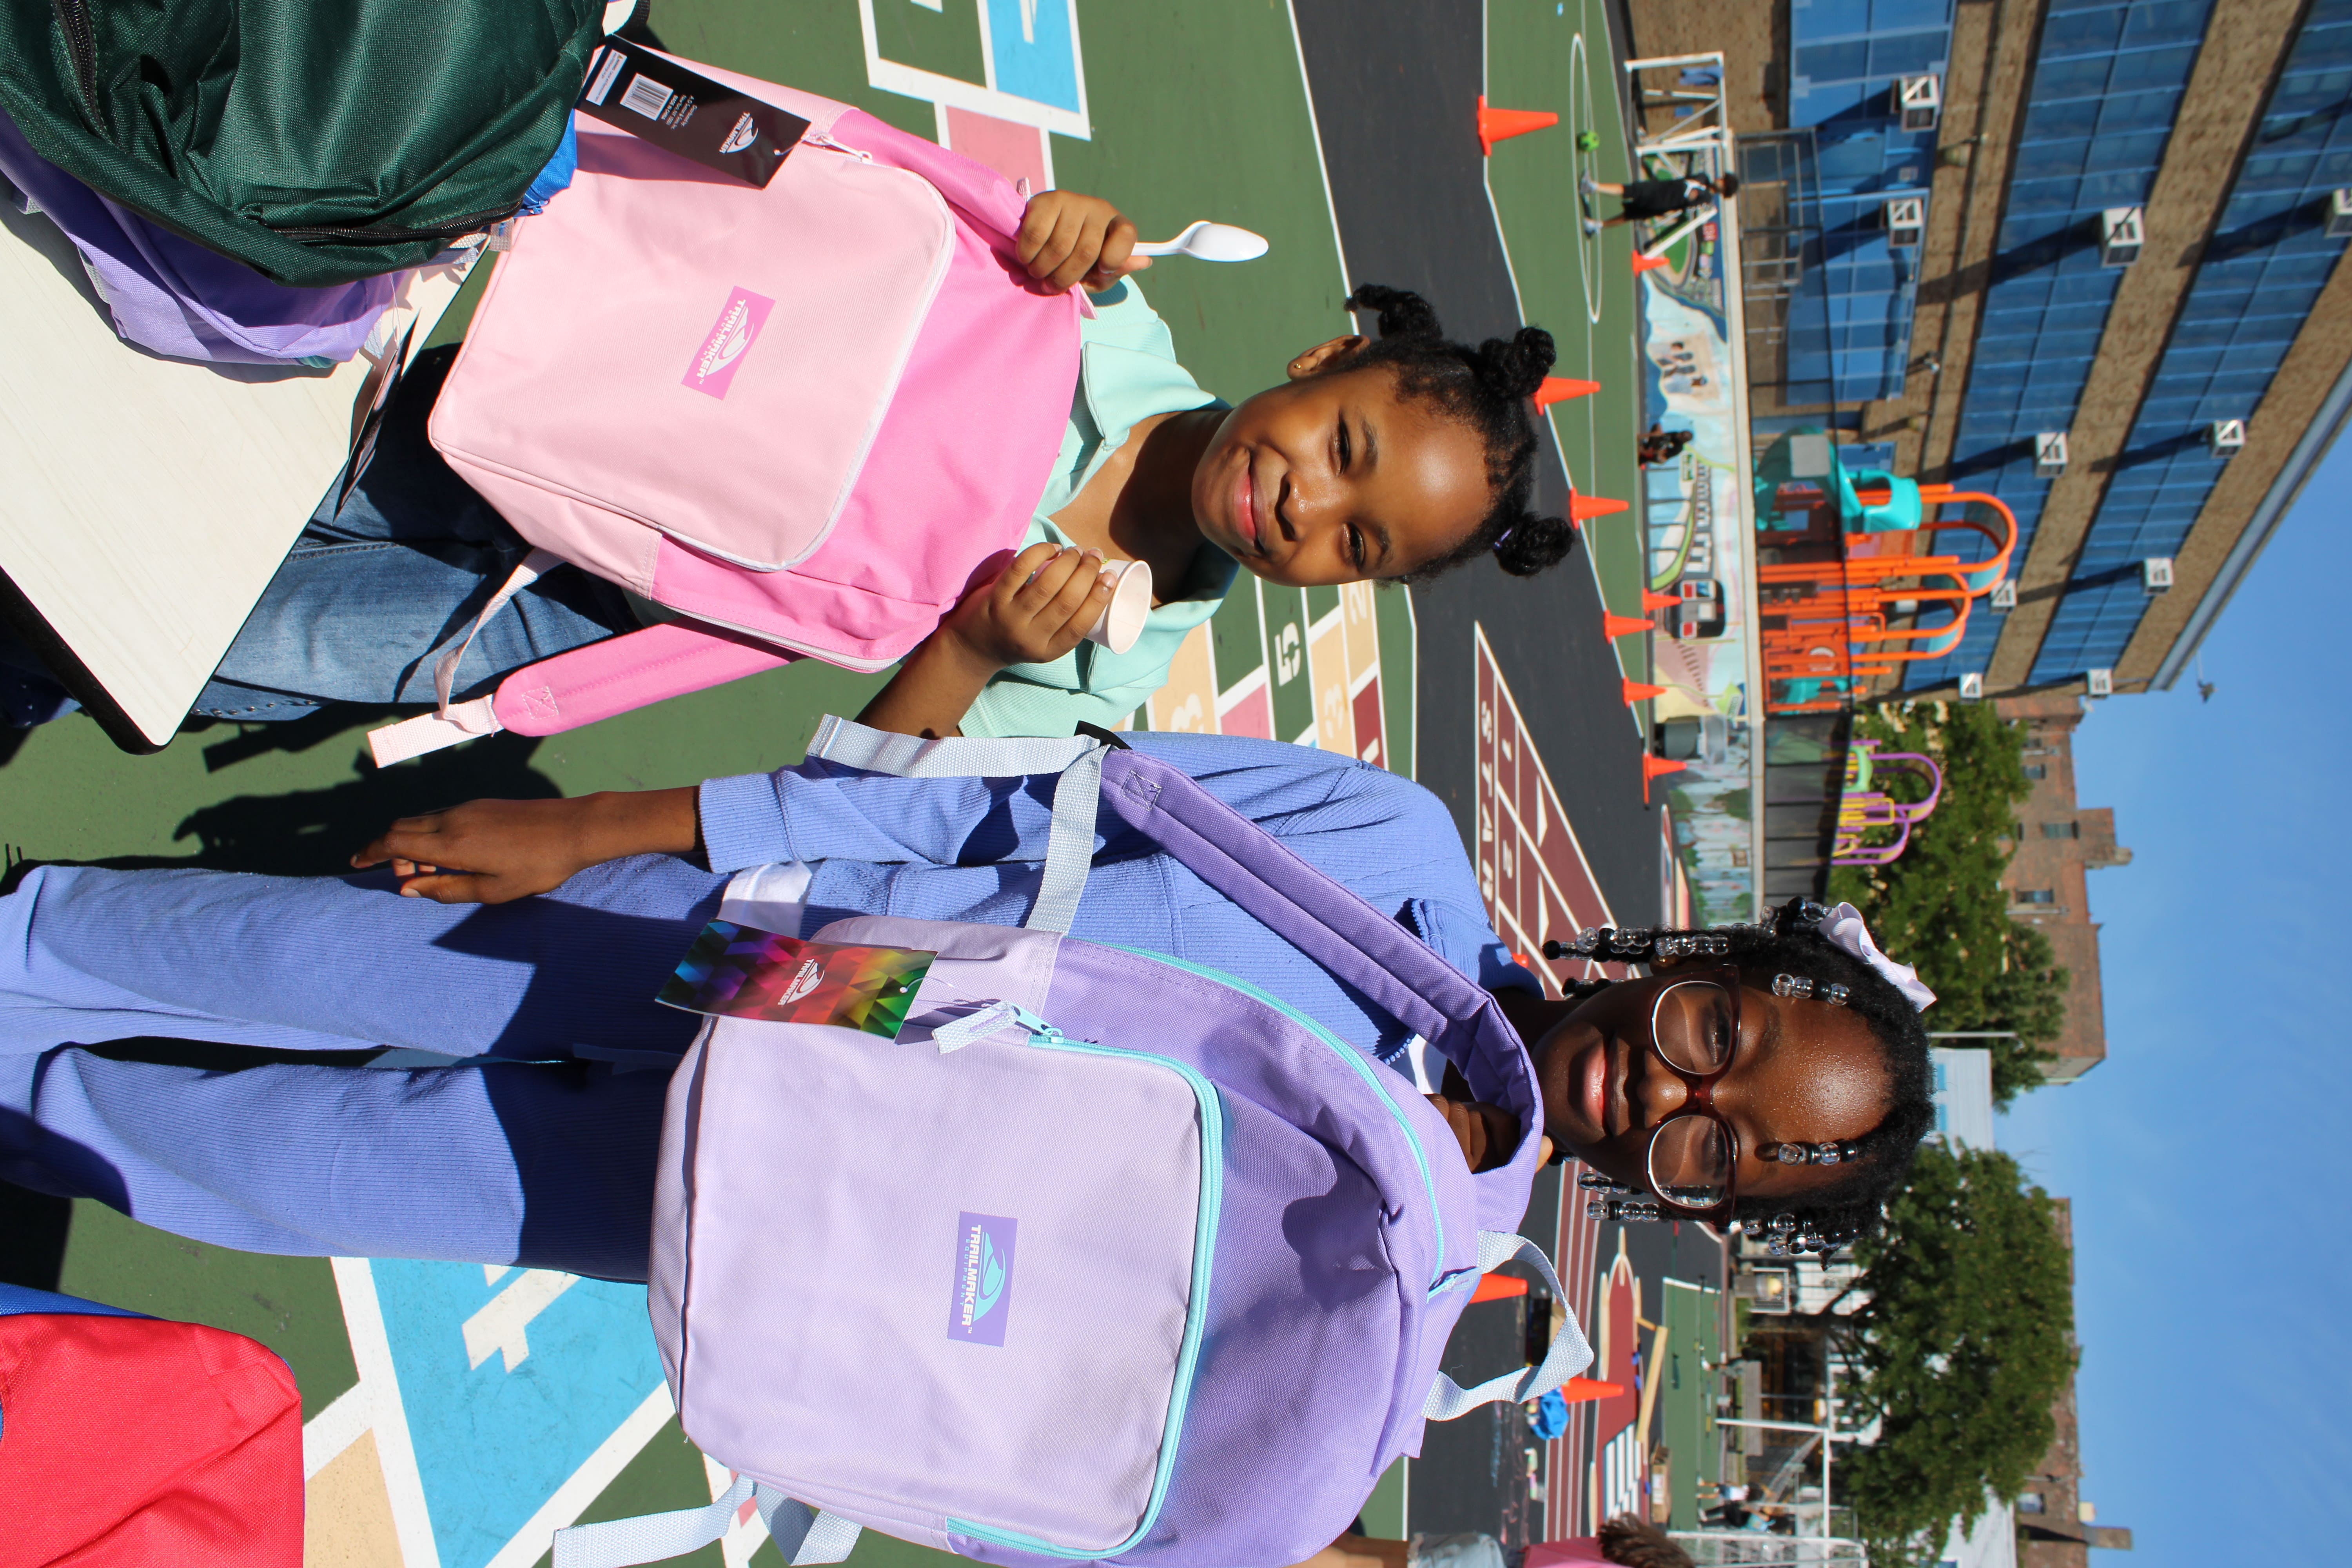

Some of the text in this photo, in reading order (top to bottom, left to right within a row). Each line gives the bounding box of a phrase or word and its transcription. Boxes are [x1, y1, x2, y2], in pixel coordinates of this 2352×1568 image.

[719, 112, 750, 154] TRAILMAKER
[696, 299, 746, 378] TRAILMAKER
[699, 310, 732, 362] EQUIPMENT
[1274, 622, 1301, 687] 5
[1481, 701, 1492, 926] STAR
[777, 958, 815, 1006] TRAILMAKER
[960, 1239, 970, 1307] EQUIPMENT
[962, 1225, 981, 1326] TRAILMAKER
